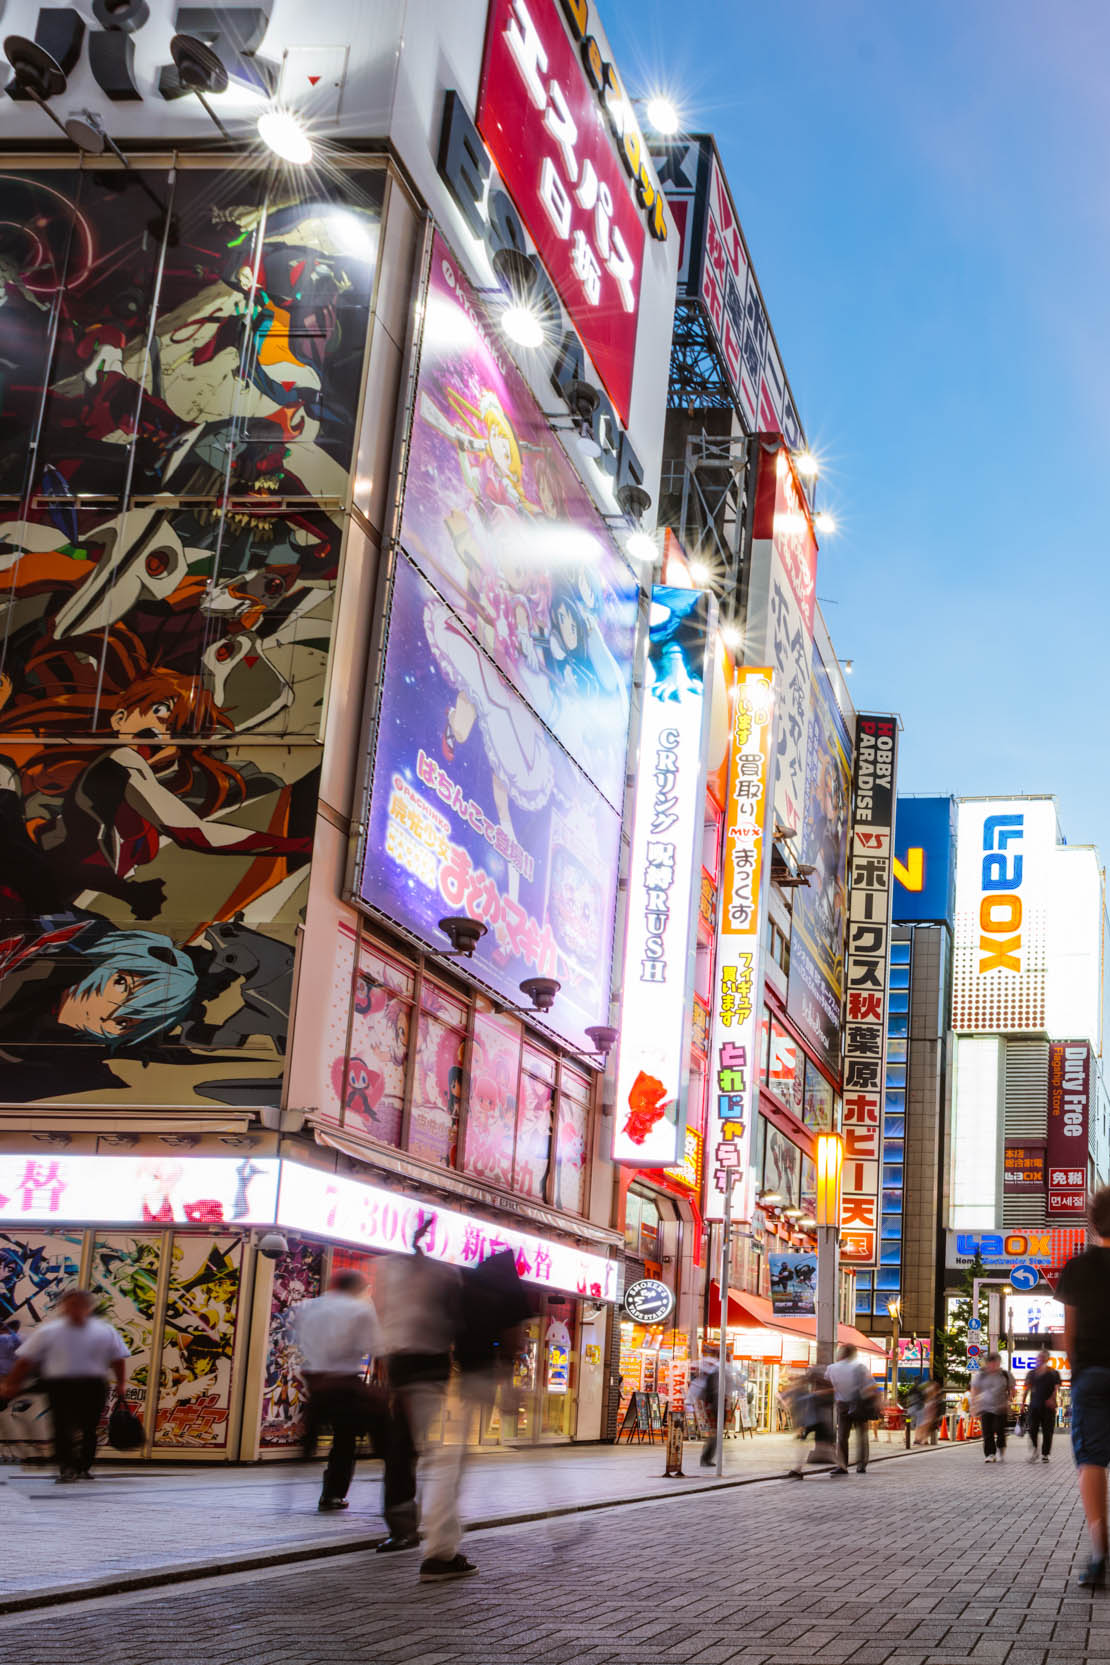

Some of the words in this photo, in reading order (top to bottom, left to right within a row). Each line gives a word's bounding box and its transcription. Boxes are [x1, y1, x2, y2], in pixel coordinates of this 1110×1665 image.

[856, 721, 877, 822] PARADISE
[875, 722, 894, 790] HOBBY
[731, 848, 758, 924] まっくす
[720, 966, 738, 1028] 買います
[737, 952, 753, 1025] フィギュア
[1062, 1047, 1088, 1091] Duty
[1063, 1094, 1087, 1137] Free
[1051, 1196, 1084, 1207] 면세점
[1053, 1171, 1083, 1185] 免税
